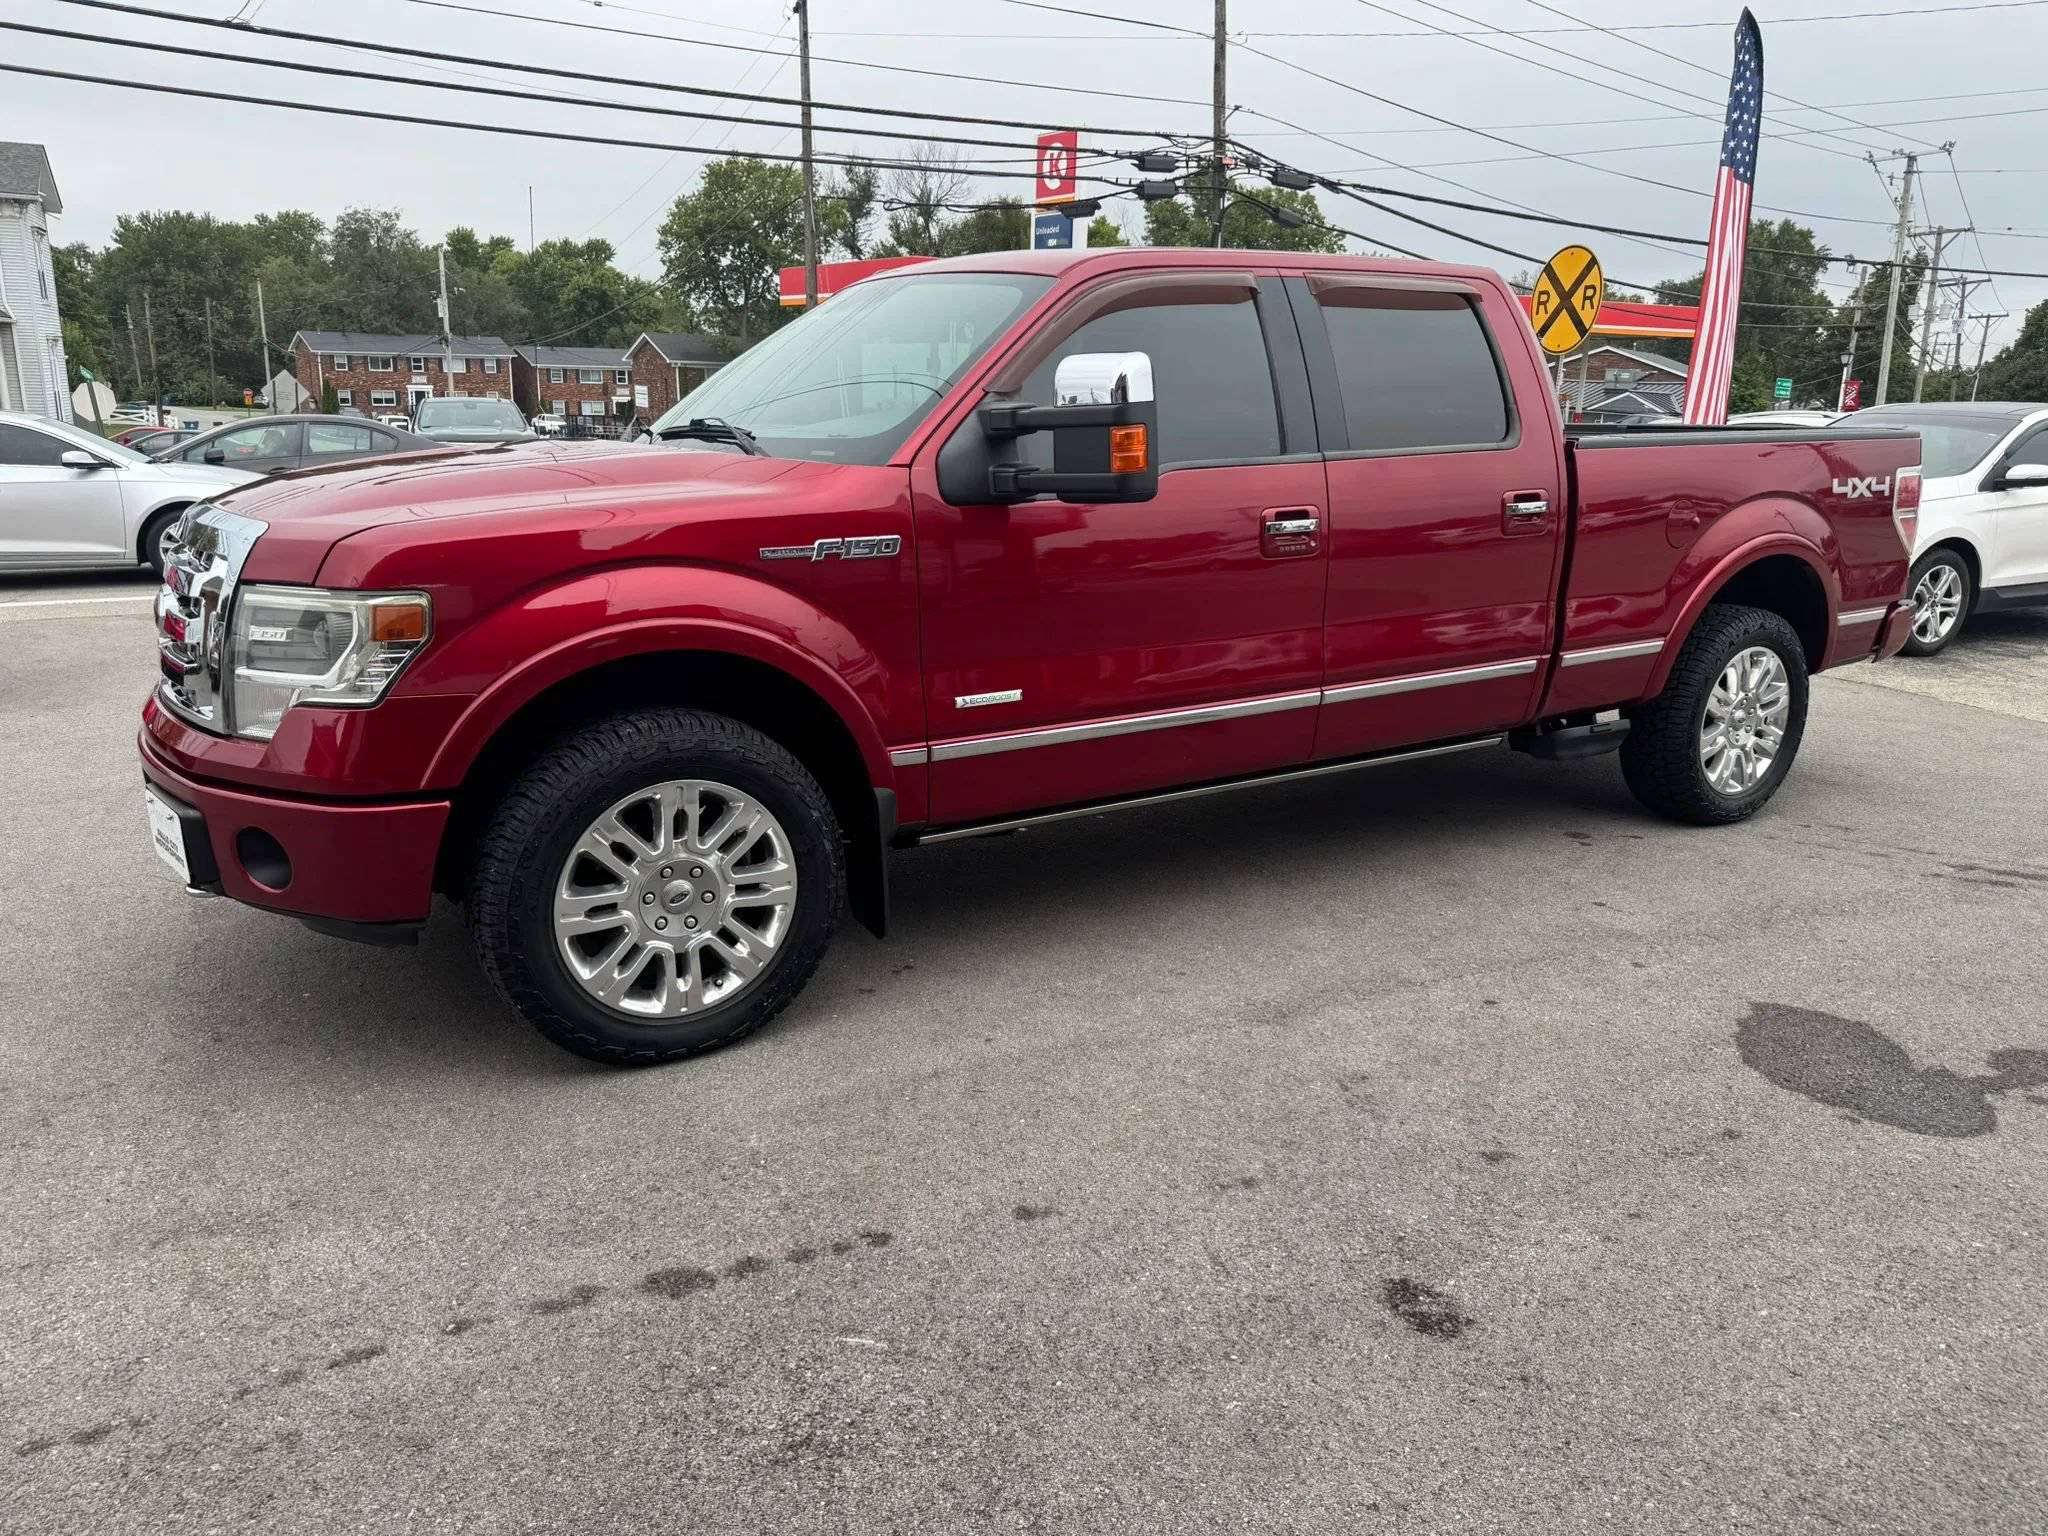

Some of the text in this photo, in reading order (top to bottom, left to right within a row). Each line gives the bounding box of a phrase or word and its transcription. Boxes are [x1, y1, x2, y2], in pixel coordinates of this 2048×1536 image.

[1036, 224, 1060, 235] Unleaded
[1536, 284, 1597, 315] R R
[811, 535, 901, 561] F-150
